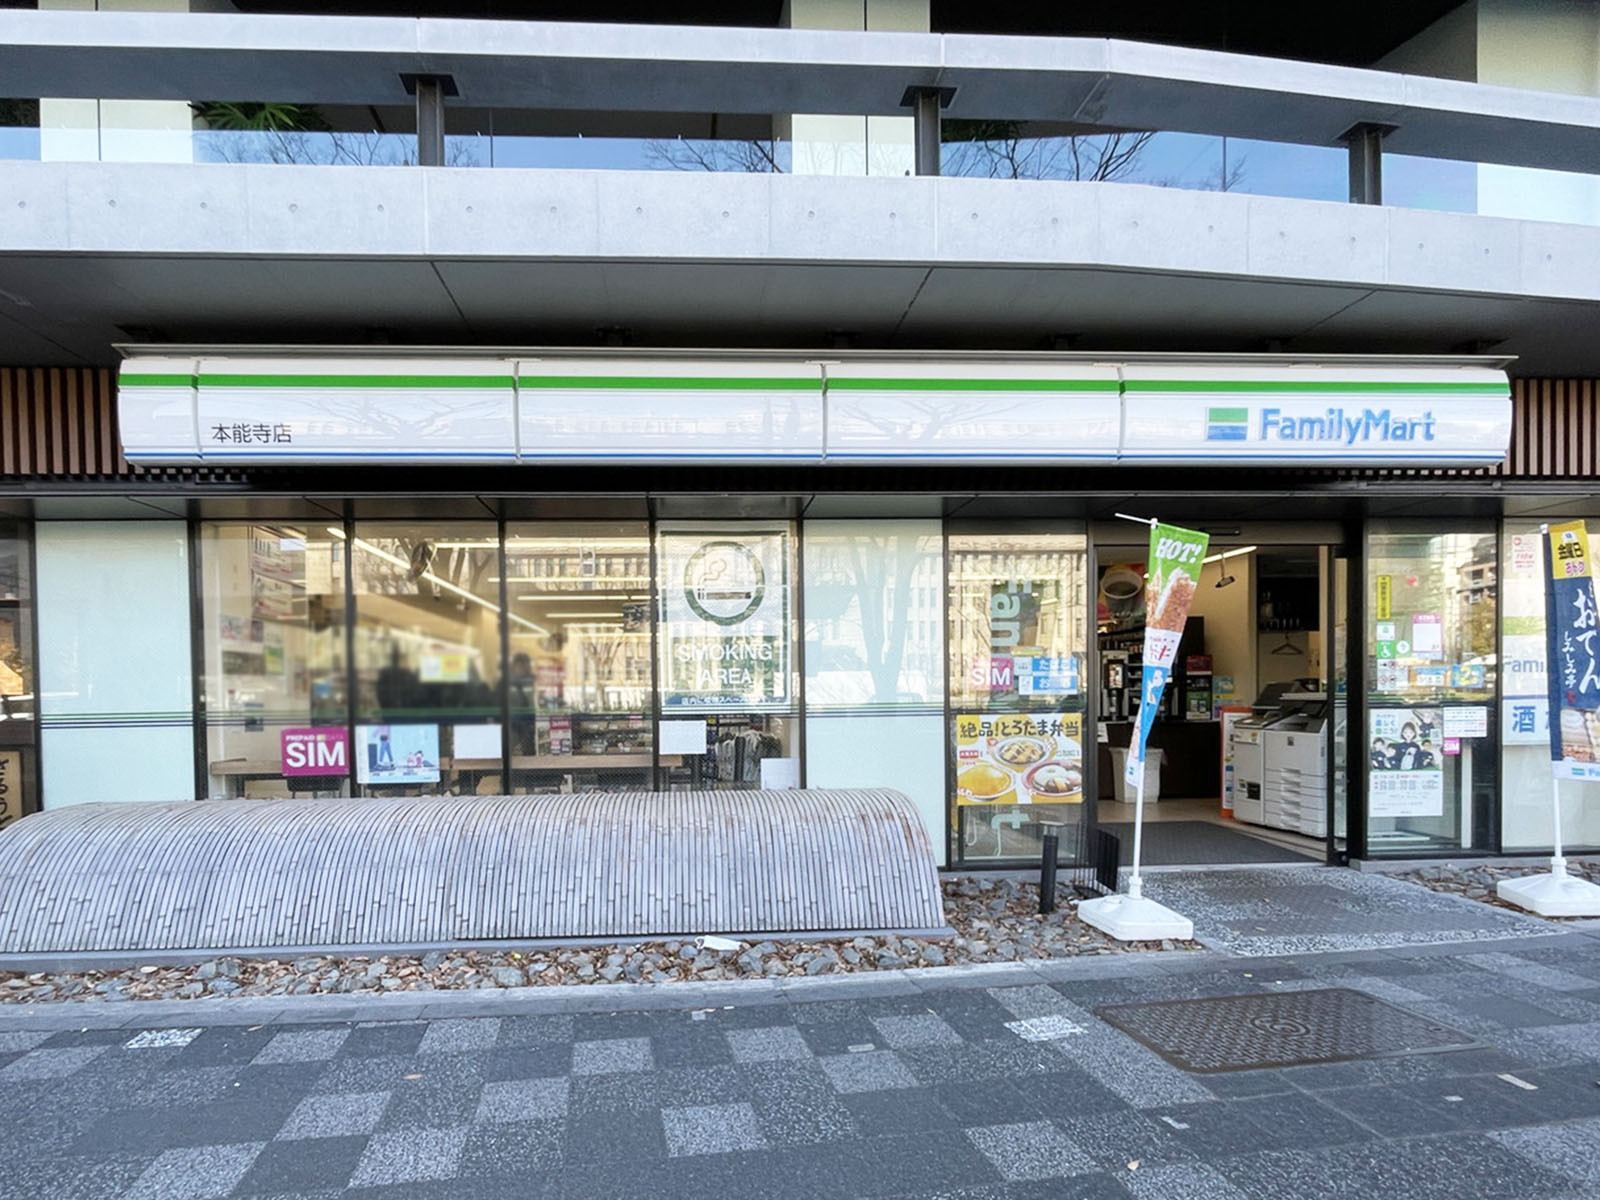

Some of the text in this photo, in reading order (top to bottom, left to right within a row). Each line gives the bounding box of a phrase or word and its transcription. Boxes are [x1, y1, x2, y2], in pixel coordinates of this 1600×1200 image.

[211, 423, 292, 443] 本能寺店
[1259, 407, 1435, 445] FamilyMart
[1156, 537, 1202, 564] HOT!
[678, 644, 773, 661] SMOKING
[702, 668, 752, 685] AREA
[972, 667, 1011, 686] SIM
[960, 719, 1080, 738] 絶品!とろたま弁当
[1512, 705, 1536, 733] 酒
[286, 742, 345, 768] SIM
